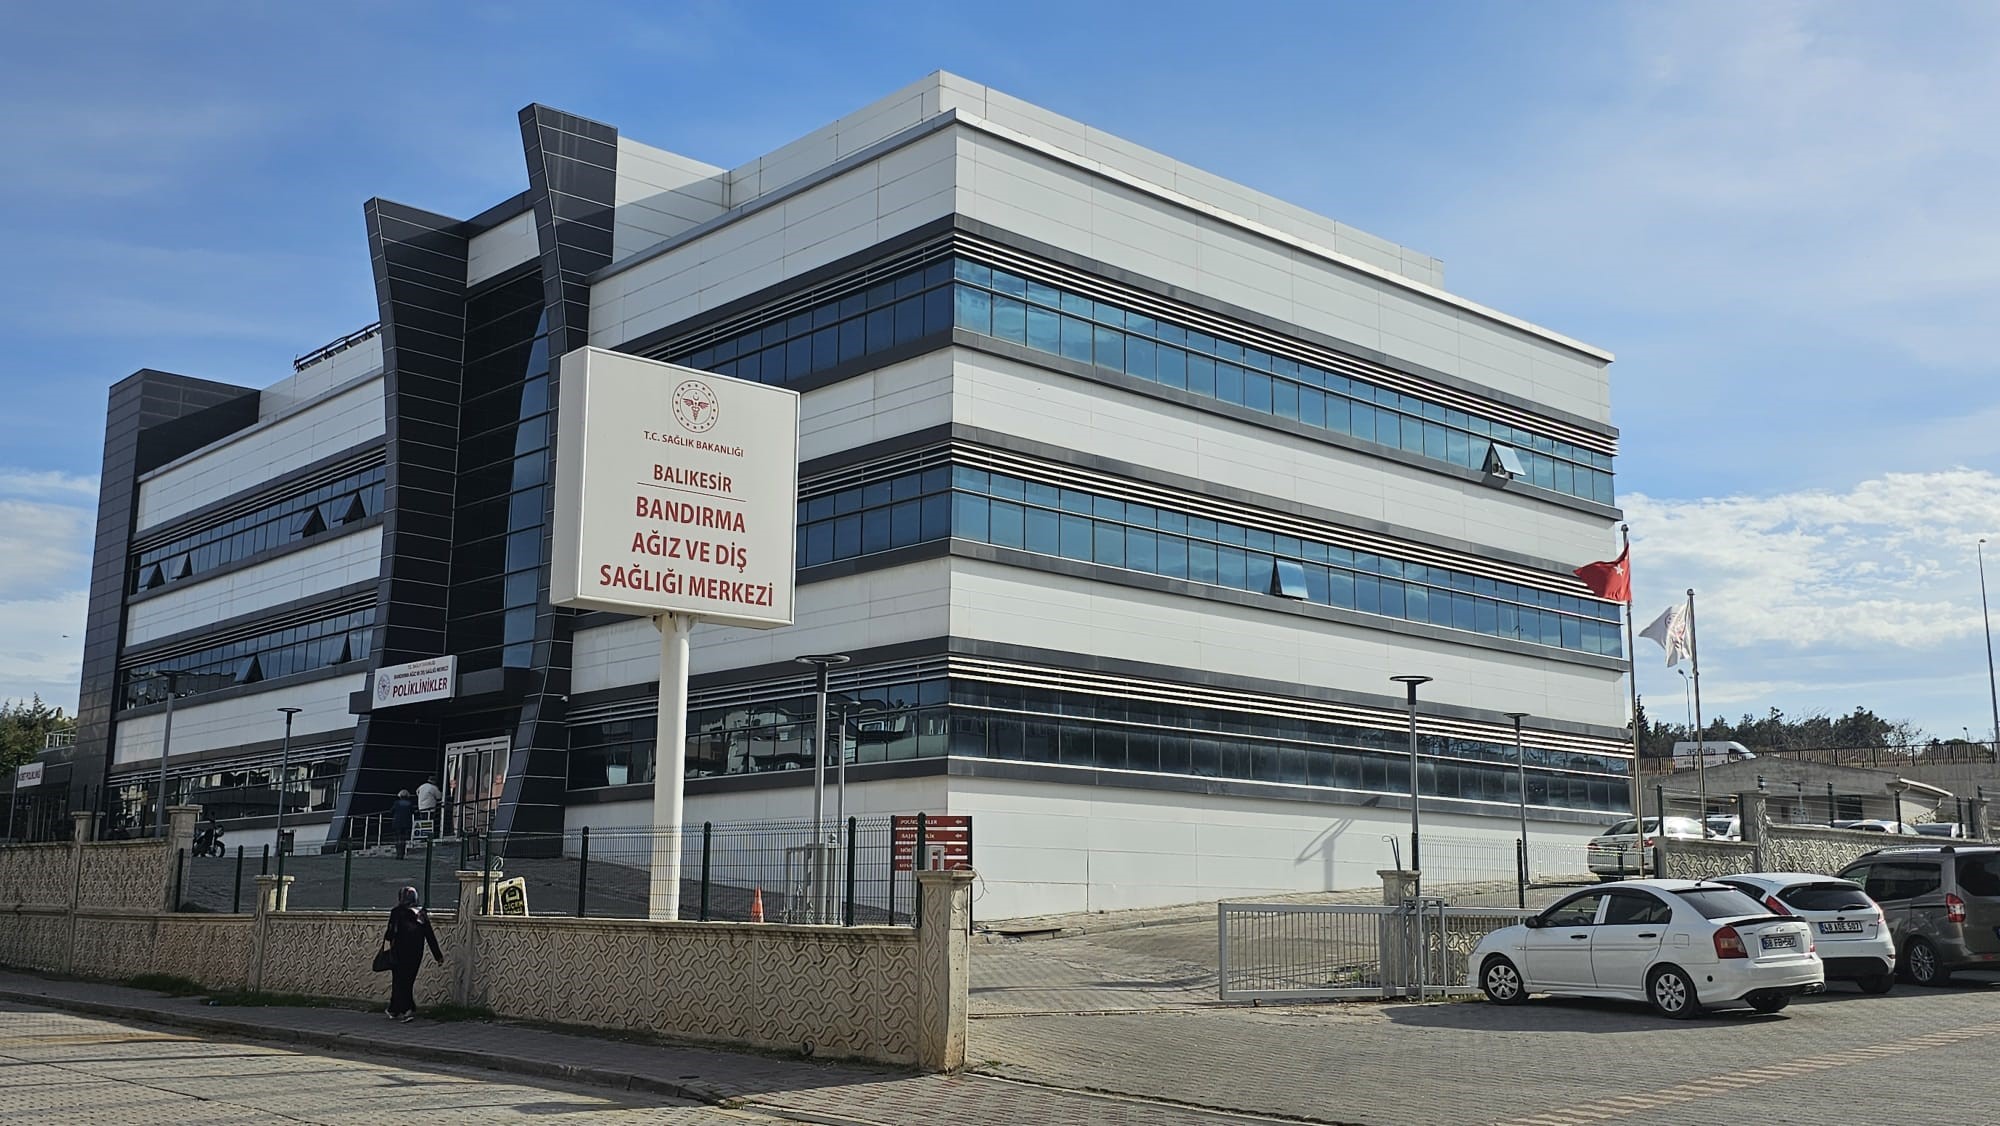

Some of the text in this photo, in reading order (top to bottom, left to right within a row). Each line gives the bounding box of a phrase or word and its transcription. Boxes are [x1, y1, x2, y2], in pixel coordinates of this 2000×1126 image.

[644, 431, 744, 457] T.C. SAĞLIK BAKANLIĞI
[654, 464, 732, 493] BALIKESİR
[636, 496, 746, 534] BANDIRMA
[631, 530, 747, 573] AĞIZ VE DİŞ
[599, 564, 773, 607] SAĞLIĞI MERKEZİ
[392, 677, 448, 698] POLİKLİNİKLER
